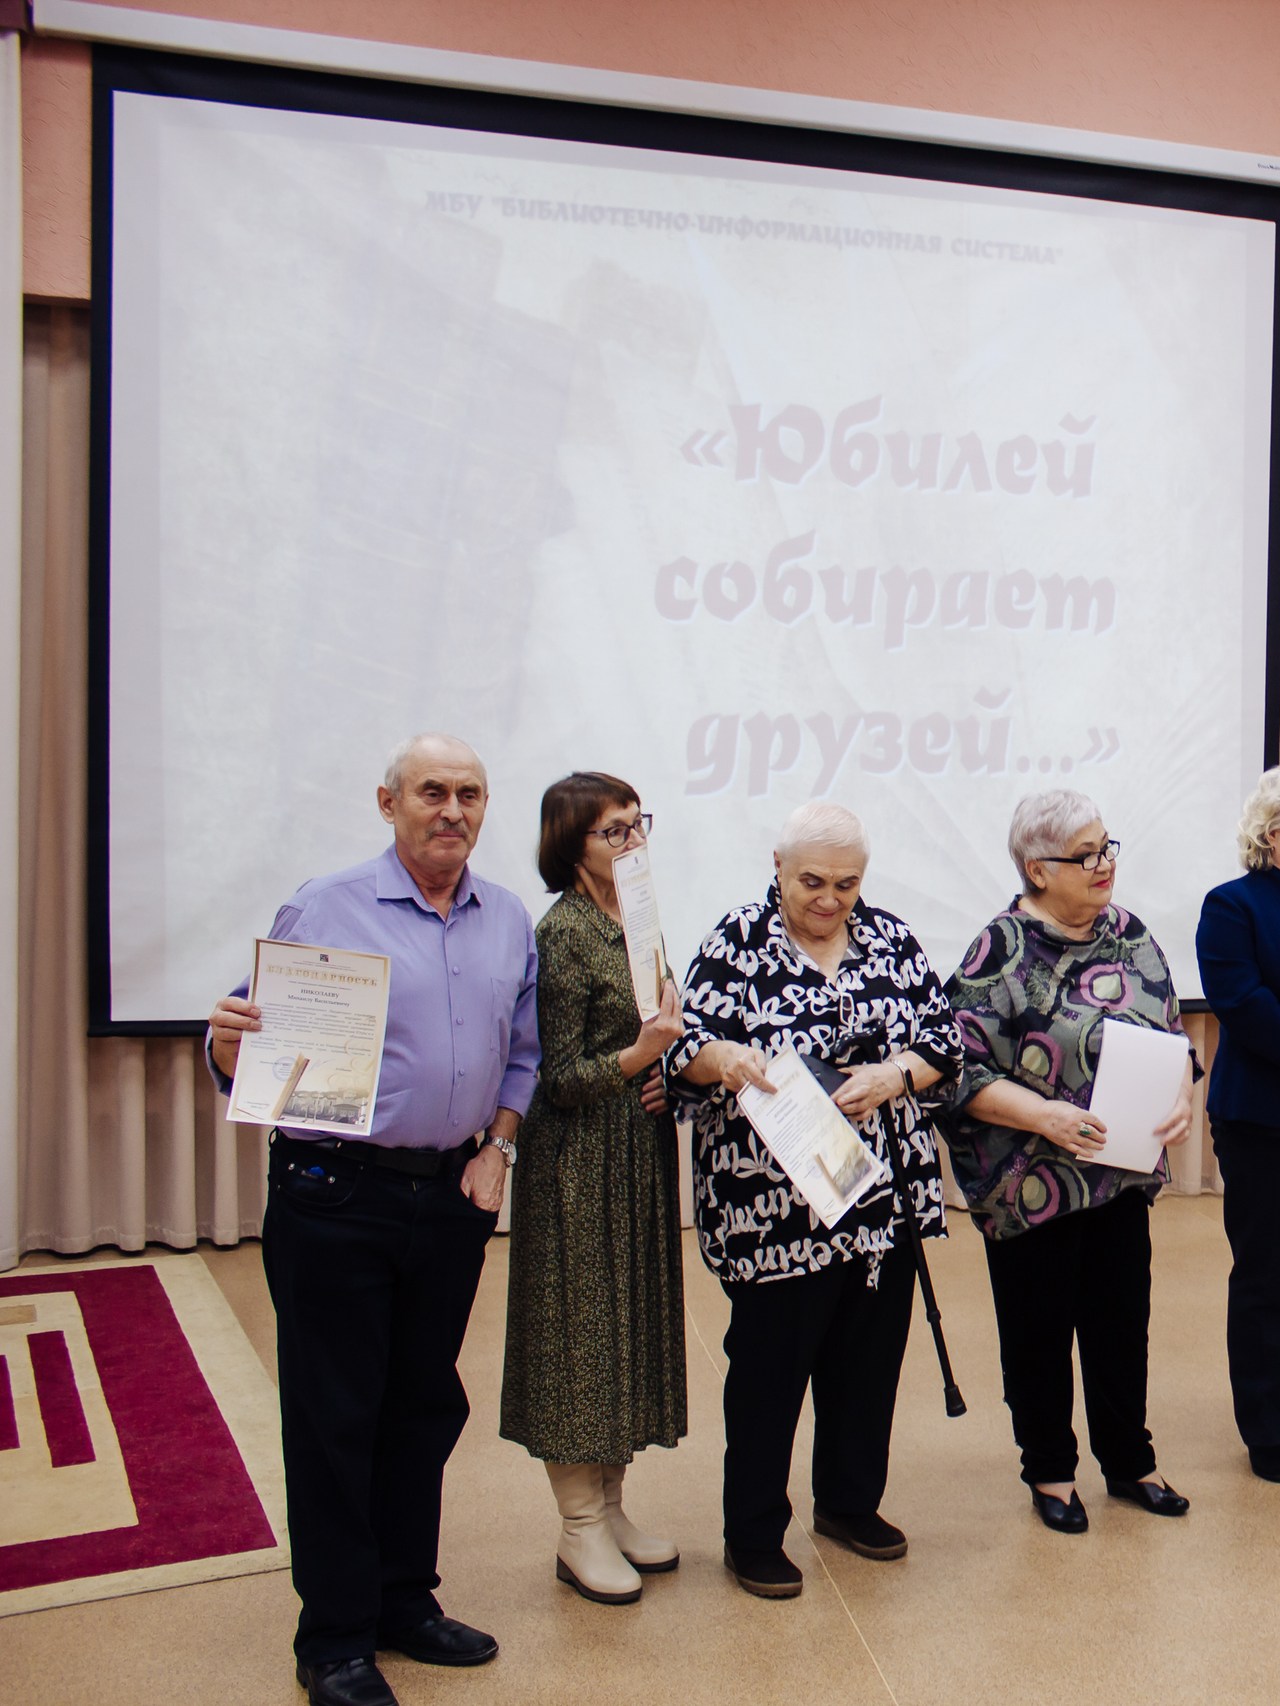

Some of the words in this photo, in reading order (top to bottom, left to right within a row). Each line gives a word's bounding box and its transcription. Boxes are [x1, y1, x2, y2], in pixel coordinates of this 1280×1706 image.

[425, 190, 484, 218] МБУ
[950, 238, 1065, 266] СИСТЕМА"
[679, 394, 1099, 499] «Юбилей
[653, 528, 1119, 652] собирает
